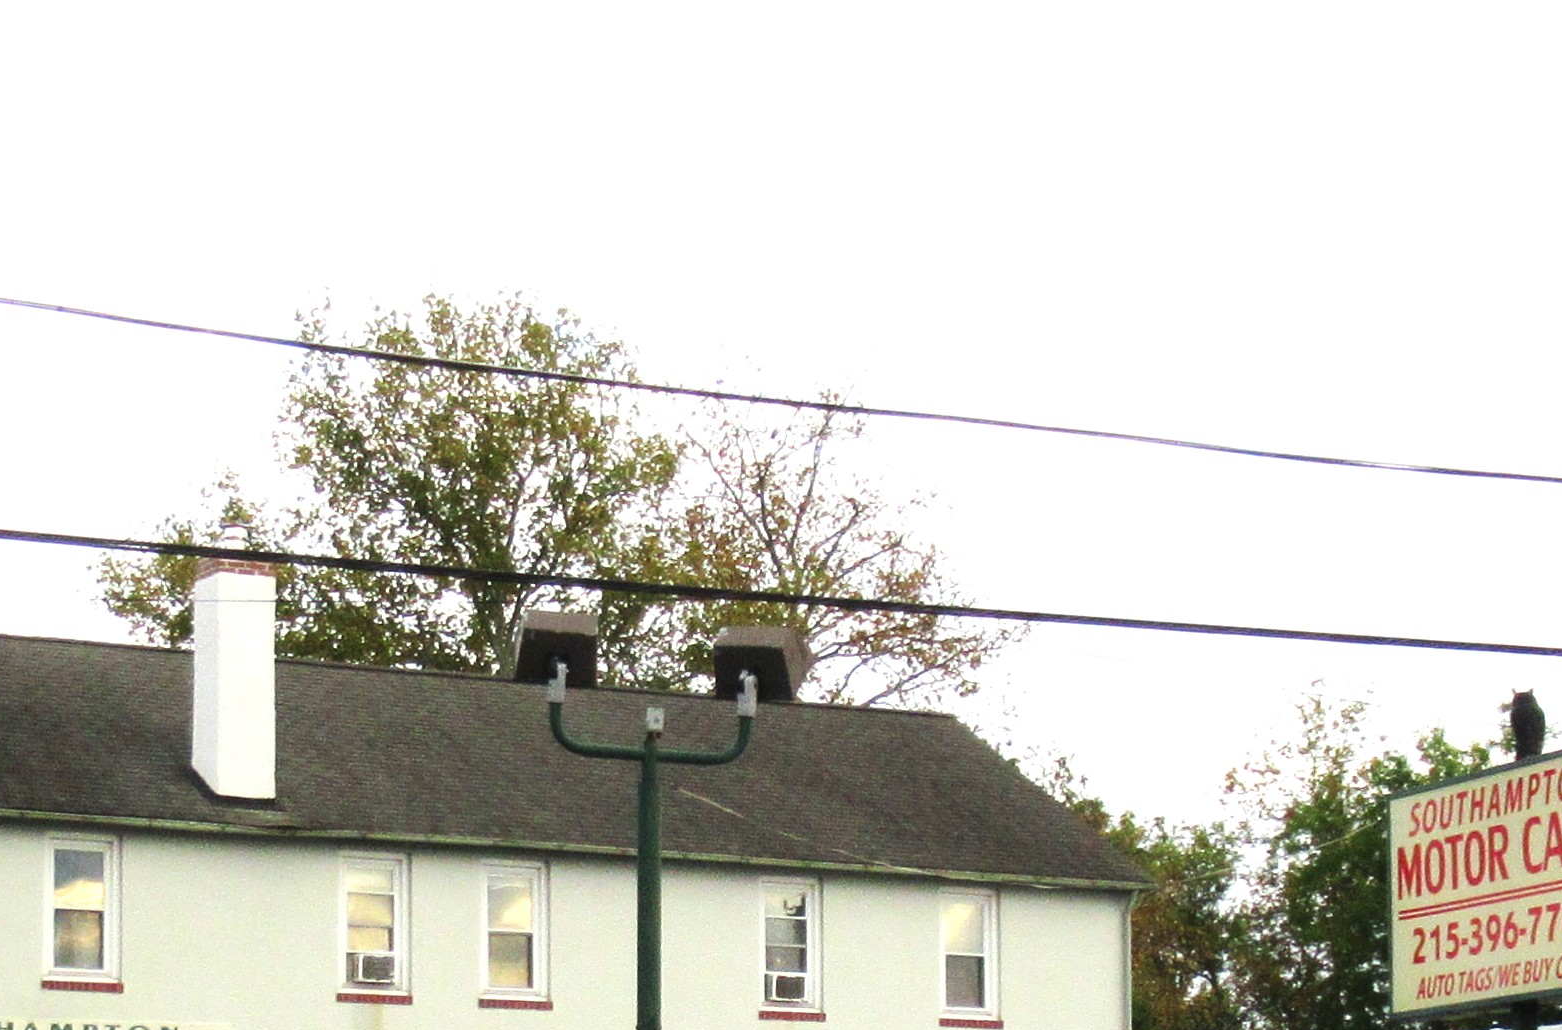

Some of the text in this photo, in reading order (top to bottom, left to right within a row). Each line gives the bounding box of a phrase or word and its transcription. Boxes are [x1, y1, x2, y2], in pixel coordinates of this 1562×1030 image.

[1397, 824, 1510, 900] MOTOR
[1416, 972, 1455, 999] AUTO
[1523, 957, 1554, 984] BUY
